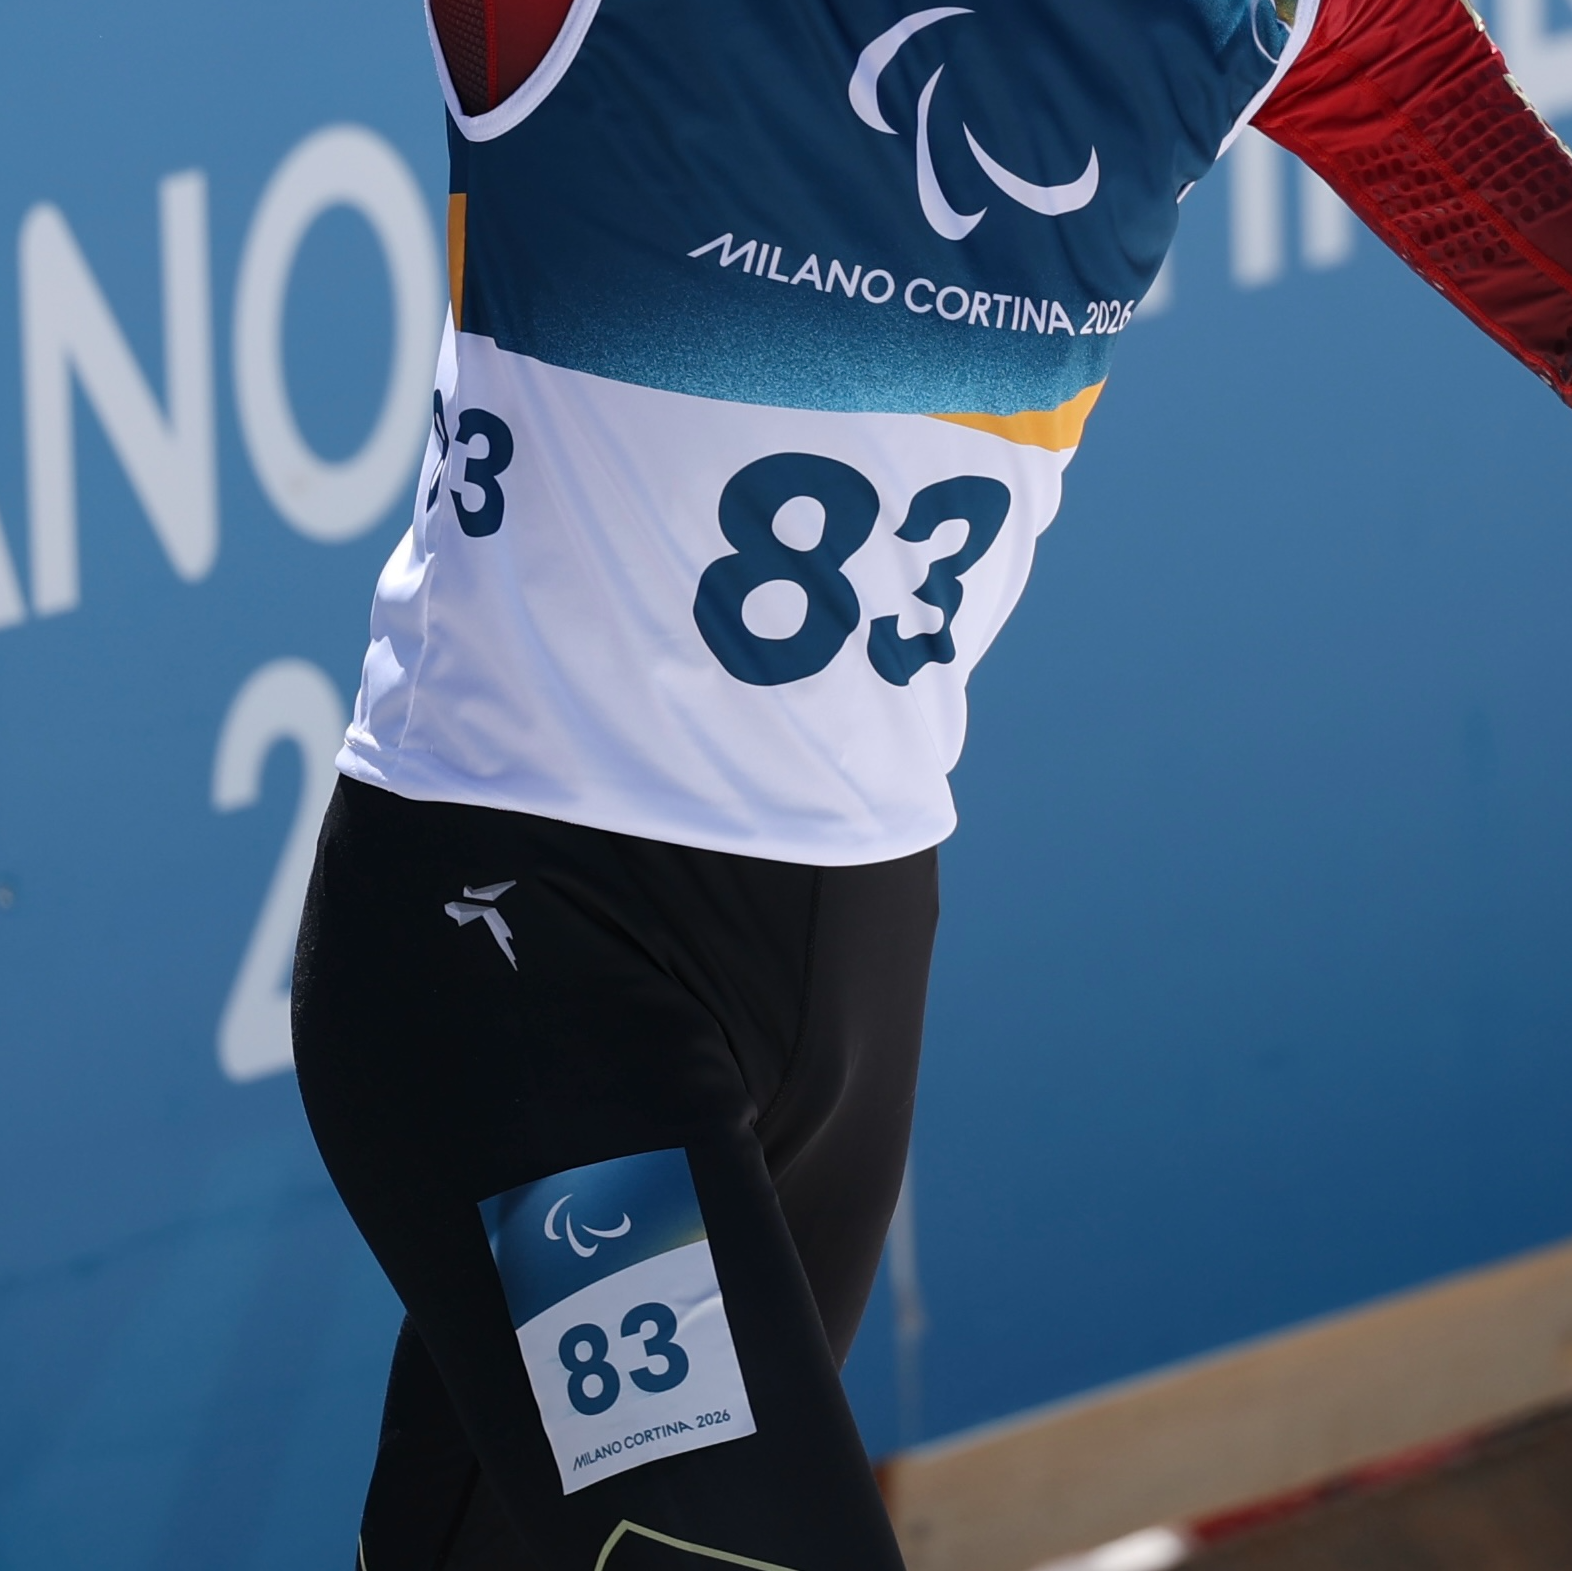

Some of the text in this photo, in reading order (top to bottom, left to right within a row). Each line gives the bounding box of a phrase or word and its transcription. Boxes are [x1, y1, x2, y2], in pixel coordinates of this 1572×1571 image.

[686, 232, 1135, 337] MILANO CORTINA 2026
[692, 451, 1012, 687] 83
[558, 1301, 689, 1416] 83
[572, 1409, 731, 1472] MILANO CORTINA 2026
